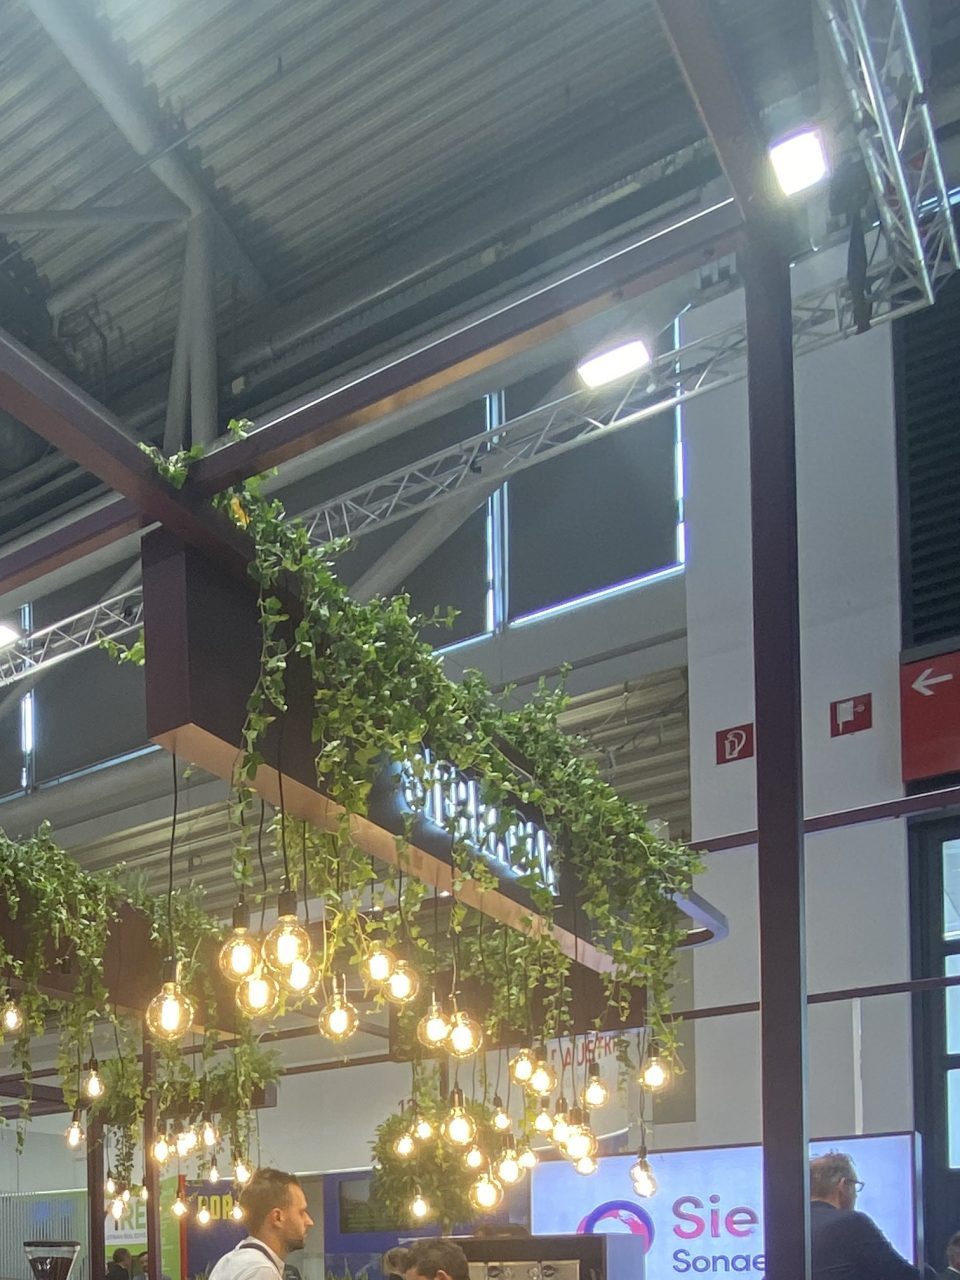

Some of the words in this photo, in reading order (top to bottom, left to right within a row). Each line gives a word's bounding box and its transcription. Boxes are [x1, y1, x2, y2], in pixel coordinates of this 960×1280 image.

[197, 1194, 238, 1220] POR
[672, 1194, 760, 1239] Sie
[672, 1248, 766, 1273] Sonae
